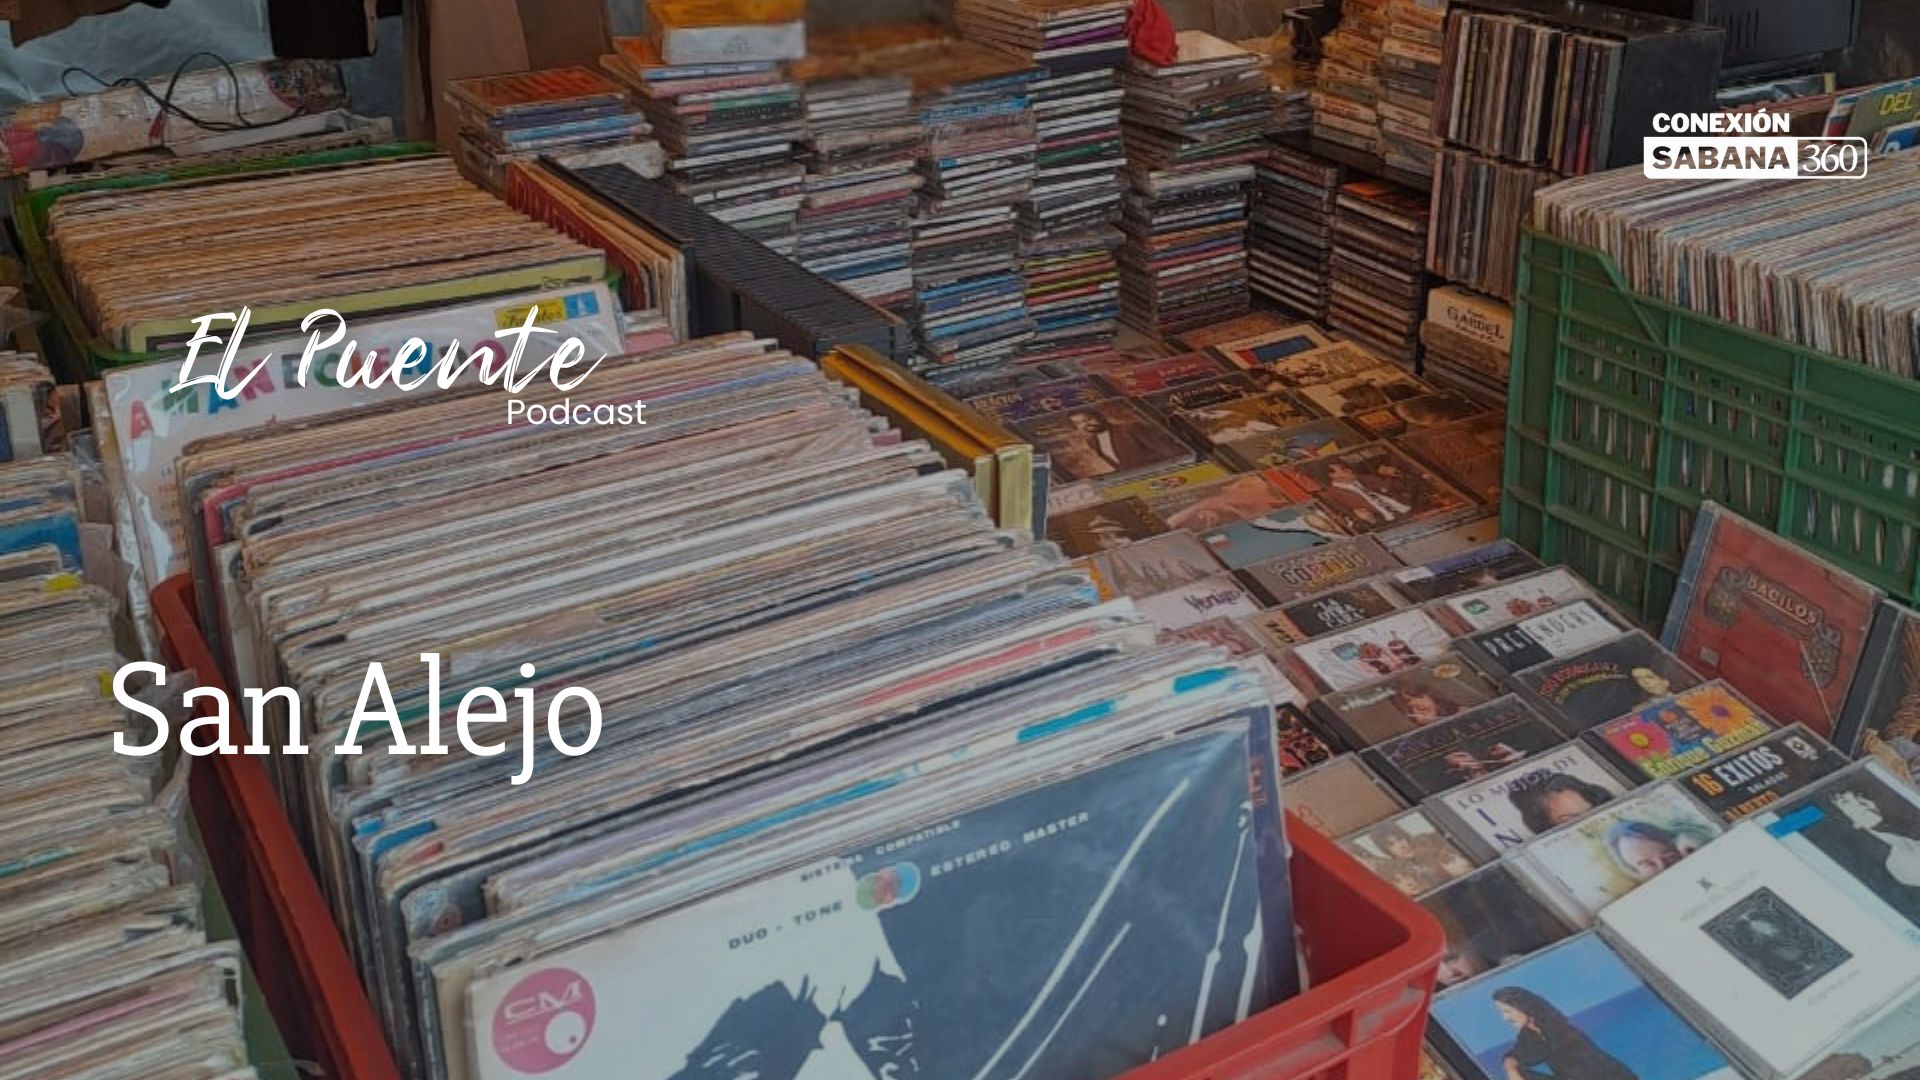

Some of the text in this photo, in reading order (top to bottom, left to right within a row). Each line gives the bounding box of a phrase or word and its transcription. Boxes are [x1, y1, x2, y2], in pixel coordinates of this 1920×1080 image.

[1746, 572, 1820, 625] BACILOS
[1457, 793, 1485, 809] LO
[1552, 755, 1579, 771] DE
[1691, 745, 1784, 797] 16 EXITOS
[1023, 811, 1090, 844] MASTER
[728, 928, 769, 950] DUO
[792, 901, 843, 927] TONE
